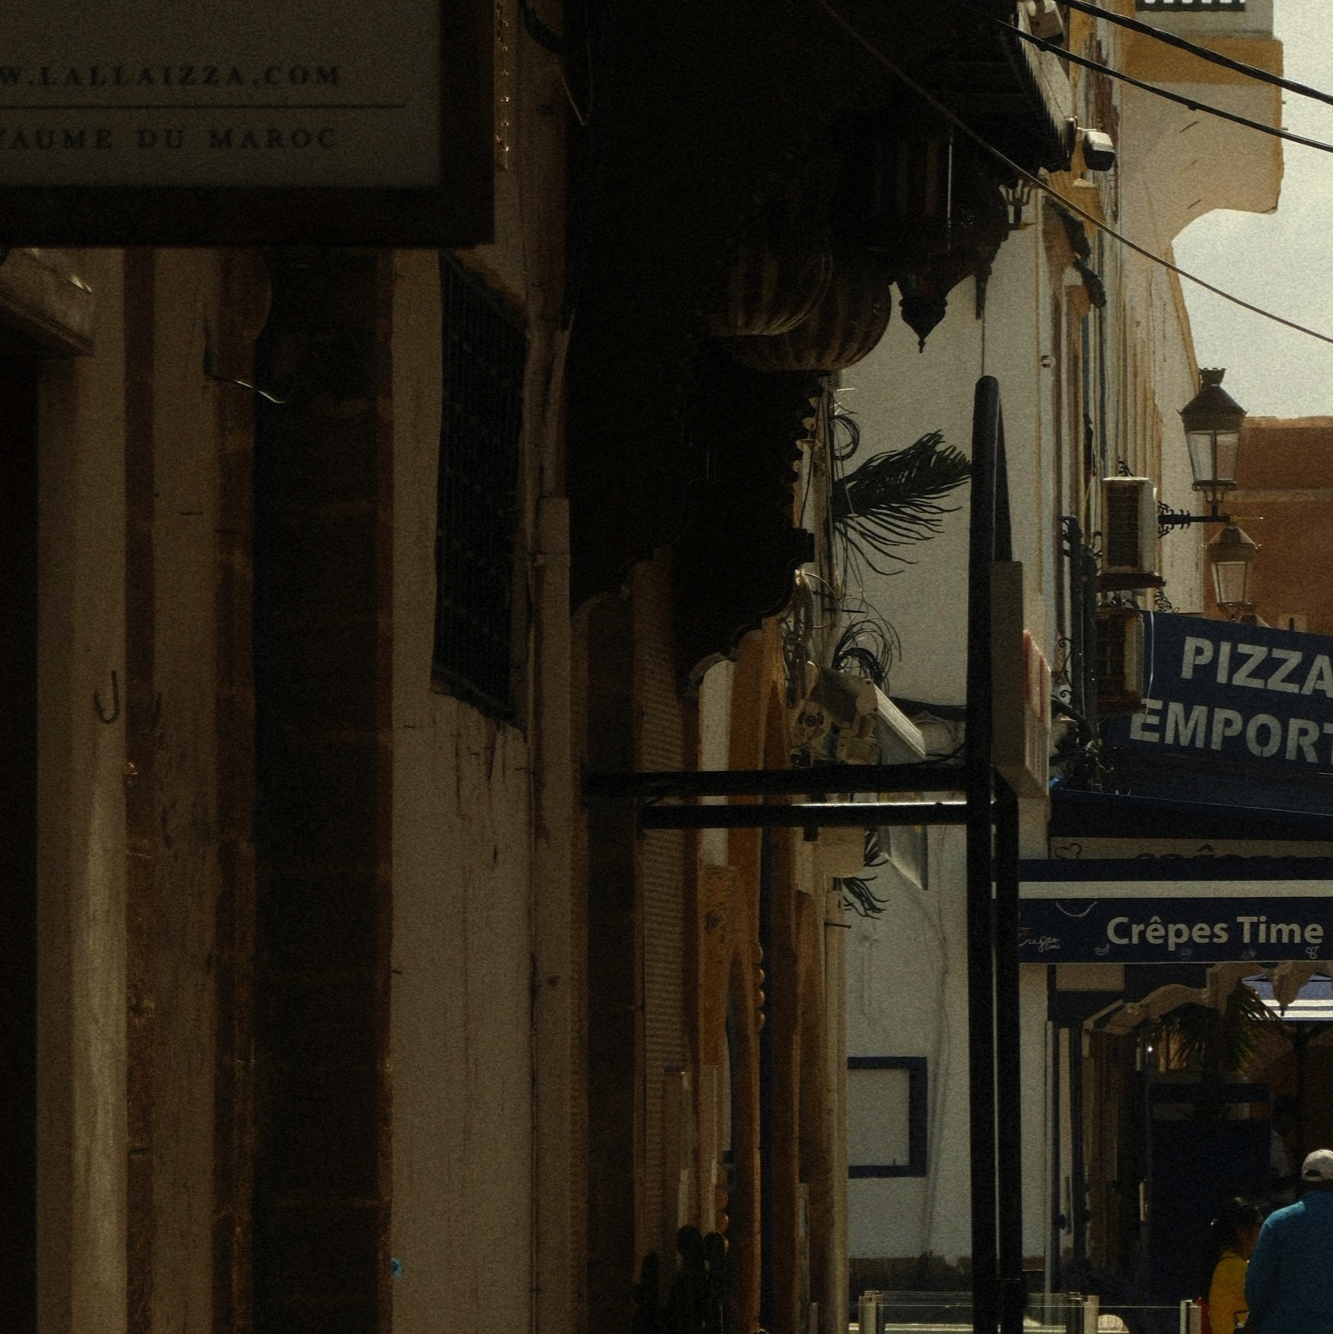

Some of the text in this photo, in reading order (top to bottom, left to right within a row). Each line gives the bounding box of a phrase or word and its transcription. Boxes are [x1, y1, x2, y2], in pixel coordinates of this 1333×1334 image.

[137, 127, 186, 150] DU
[208, 127, 336, 150] MAROC
[1106, 915, 1325, 951] Crêpes Time
